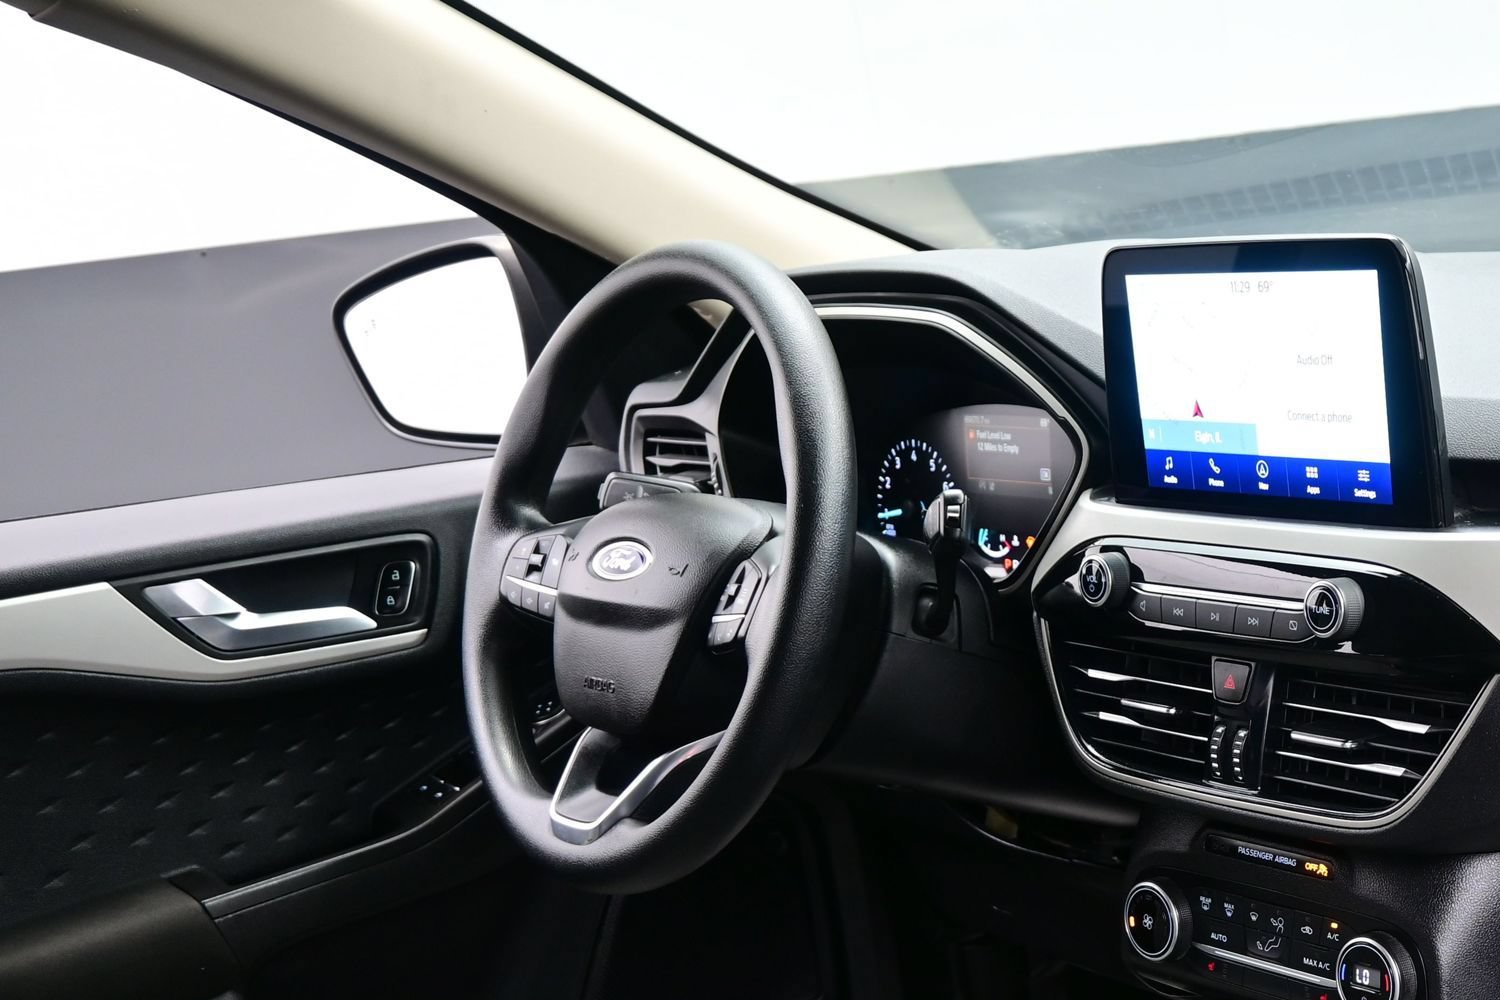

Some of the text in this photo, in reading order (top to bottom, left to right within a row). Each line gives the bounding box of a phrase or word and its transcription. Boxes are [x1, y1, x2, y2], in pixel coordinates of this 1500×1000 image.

[1296, 354, 1334, 367] Audio Off
[1287, 410, 1319, 422] Connect
[1327, 412, 1353, 425] phone
[910, 449, 917, 462] 4
[895, 456, 901, 469] 3
[929, 458, 936, 472] 5
[884, 476, 891, 489] 2
[1163, 475, 1178, 485] Audio
[1208, 477, 1224, 488] Phone
[1306, 485, 1320, 495] Apps
[1354, 489, 1377, 499] Settings
[1086, 575, 1098, 584] VOL
[1311, 605, 1330, 616] TUNE
[583, 676, 616, 694] AIRBAG
[1237, 845, 1319, 872] PASSENGER AIRBAG OFF
[1199, 895, 1212, 903] REAR
[1223, 902, 1235, 910] MAX
[1210, 931, 1228, 943] AUTO
[1327, 931, 1340, 942] A/C
[1303, 957, 1331, 971] MAX A/C
[1355, 968, 1370, 985] LO
